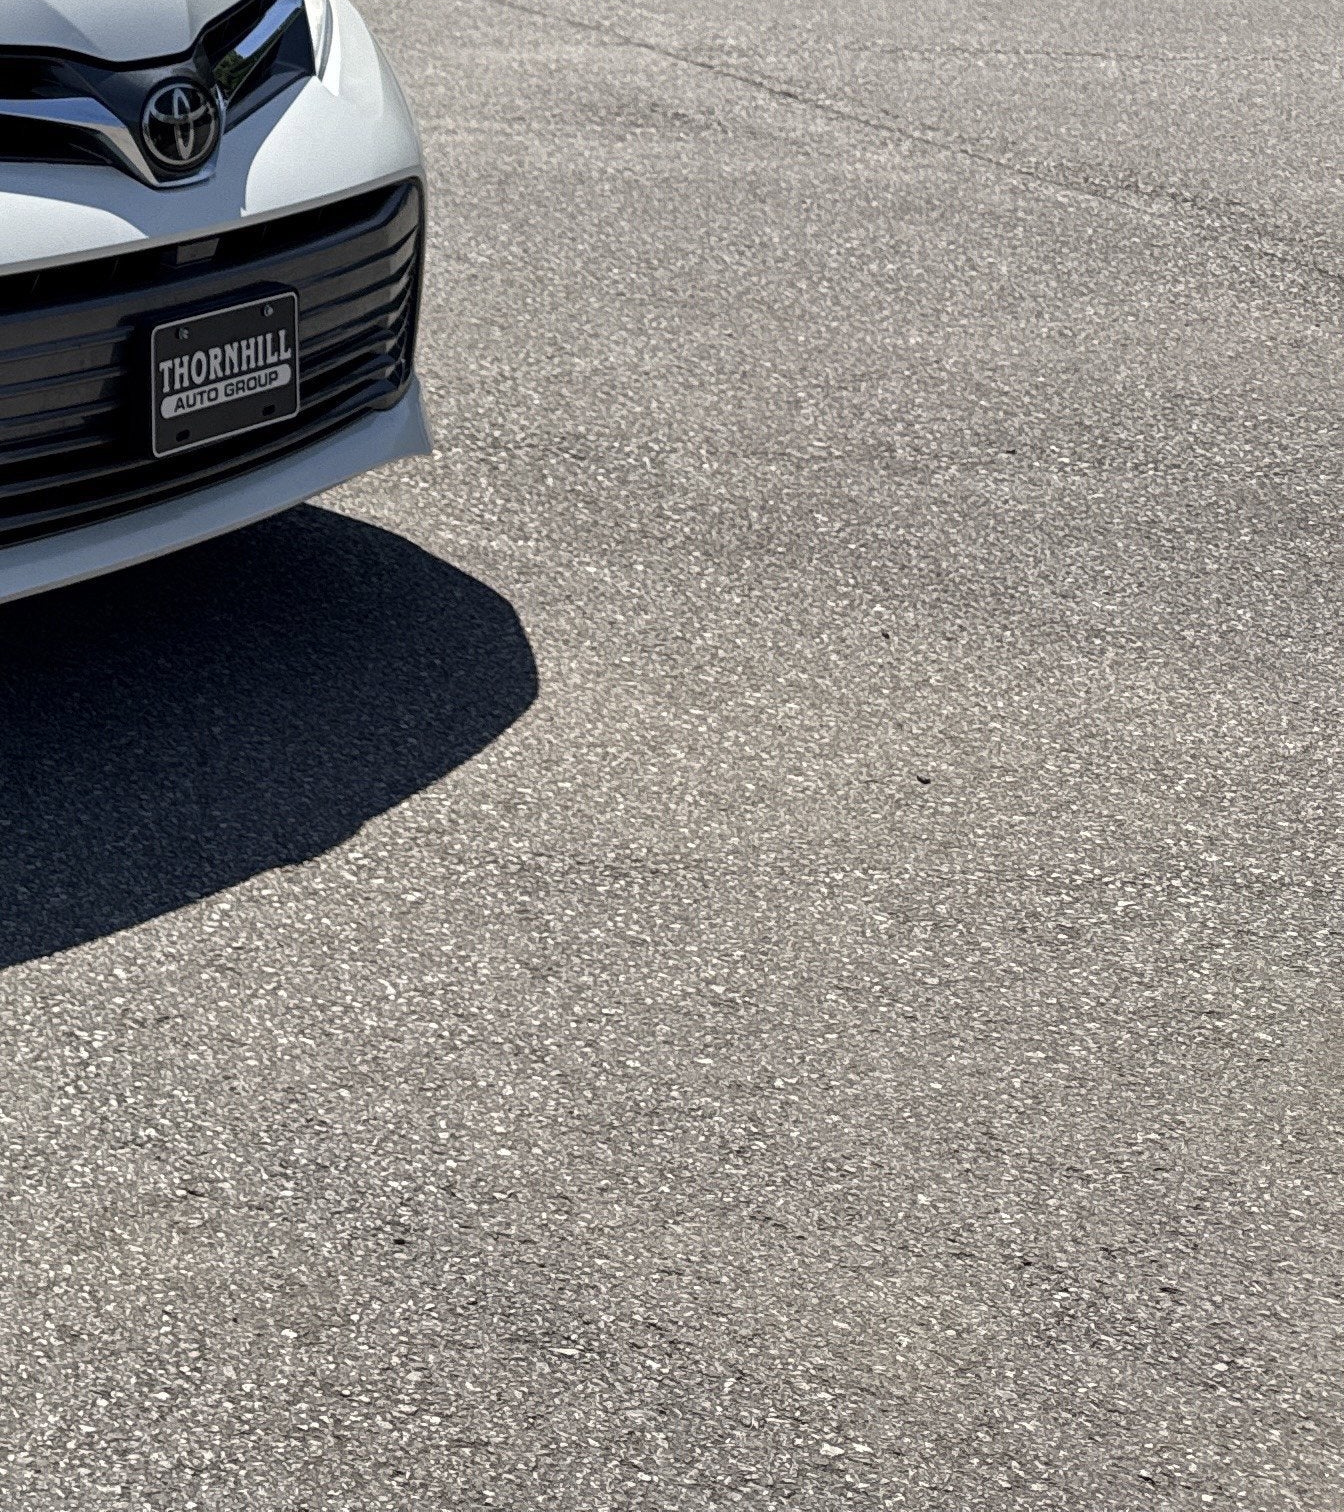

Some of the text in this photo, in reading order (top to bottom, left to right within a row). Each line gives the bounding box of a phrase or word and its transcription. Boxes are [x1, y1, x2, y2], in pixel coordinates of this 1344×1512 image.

[159, 329, 292, 393] THORNHILL
[174, 370, 279, 413] AUTO GROUP
